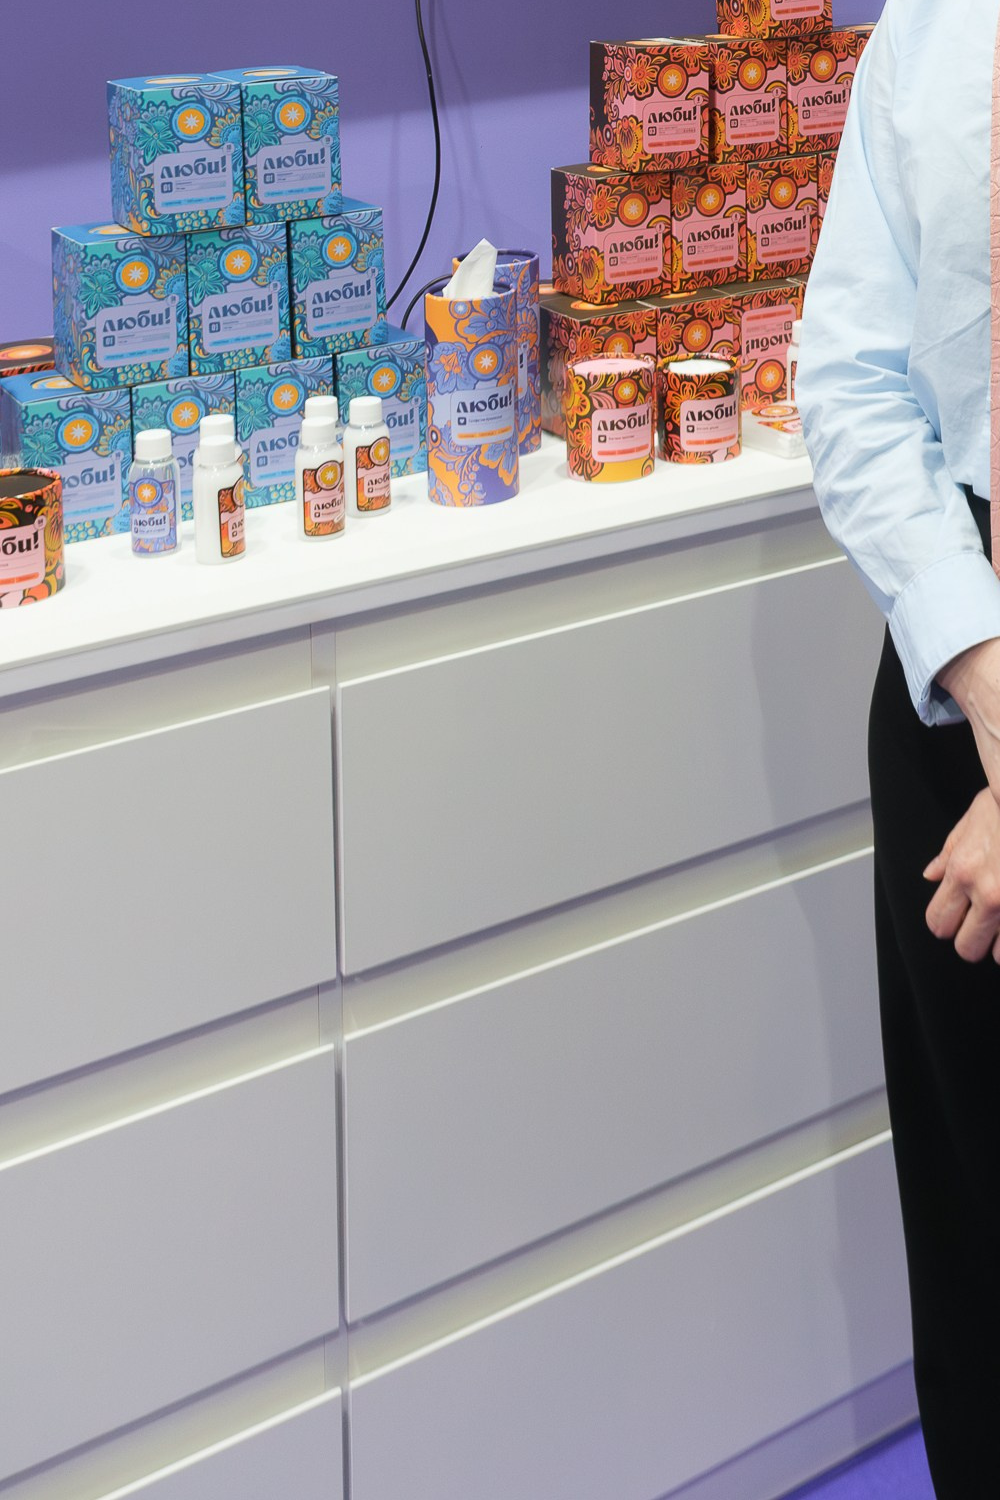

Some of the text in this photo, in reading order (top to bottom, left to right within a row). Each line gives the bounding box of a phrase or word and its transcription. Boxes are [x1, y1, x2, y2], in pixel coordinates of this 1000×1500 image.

[729, 98, 776, 116] люби!
[802, 88, 847, 108] люби!
[648, 105, 697, 124] люби!
[160, 155, 227, 180] люби!
[263, 149, 326, 171] люби!
[687, 223, 735, 243] люби!
[760, 214, 807, 235] люби!
[609, 234, 659, 254] люби!
[311, 279, 372, 305] люби!
[208, 293, 273, 319] люби!
[102, 307, 171, 333] люби!
[457, 388, 512, 413] люби!
[686, 401, 737, 421] люби!
[386, 409, 415, 429] би!
[597, 407, 650, 431] люби!
[256, 430, 300, 454] люб
[62, 464, 116, 489] юби!
[0, 530, 39, 555] би!
